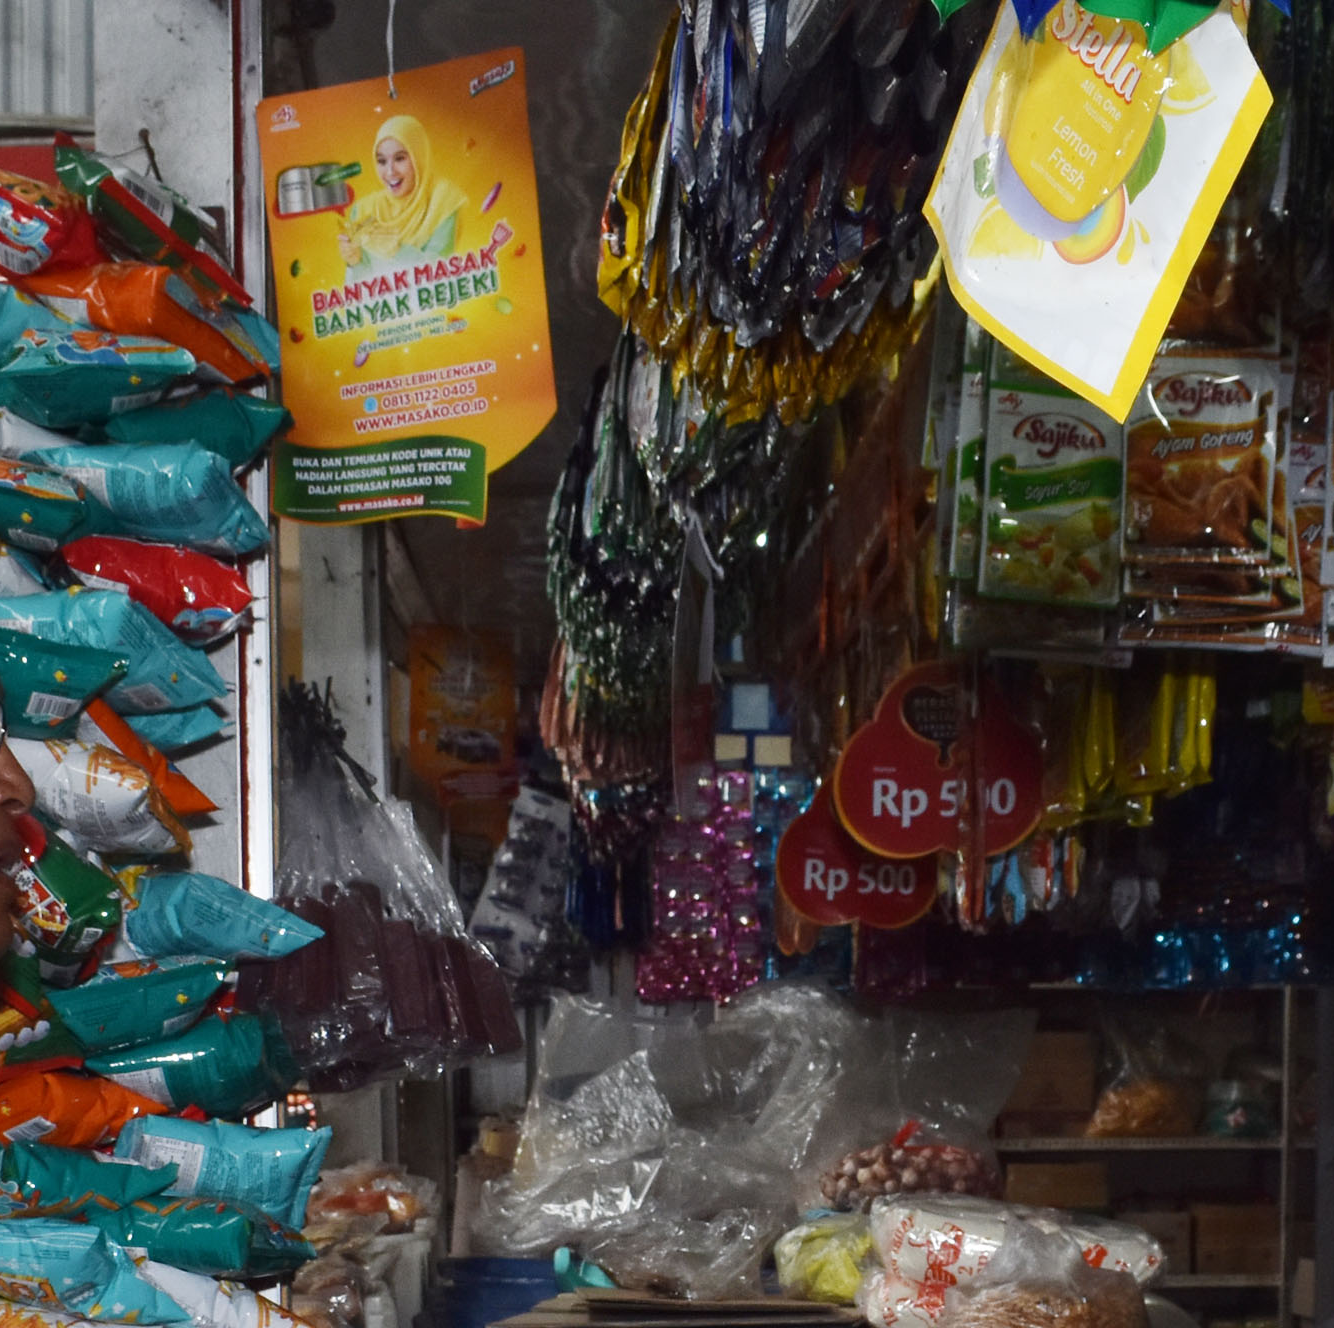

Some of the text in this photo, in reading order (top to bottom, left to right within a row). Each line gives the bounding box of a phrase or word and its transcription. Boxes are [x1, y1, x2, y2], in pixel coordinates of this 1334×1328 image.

[1052, 0, 1142, 105] Stella
[1080, 79, 1095, 98] All
[1102, 98, 1123, 121] One
[1052, 116, 1099, 166] Lemon
[1048, 147, 1087, 192] Fresh
[312, 247, 499, 313] BANYAK MASAK
[314, 269, 500, 338] BANYAK REJEKI
[341, 361, 497, 398] INFORMASI LEBIH LENGKAP:
[382, 382, 476, 410] 0813 1122 0405
[1165, 378, 1245, 417] Sajiku
[355, 398, 488, 432] WWW.MASAKO.CO.ID
[293, 447, 471, 468] BUKA DAN TEMUKAN KODE UNIK ATAU
[1024, 420, 1100, 459] Sajiku
[1150, 429, 1255, 459] Ayam Goreng
[308, 475, 453, 496] DALAM KEMASAN MASAKO 10G
[335, 467, 387, 481] LANGSUNG
[388, 464, 416, 476] YANG
[417, 461, 467, 472] TERCETAK
[339, 495, 424, 513] www.masako.co.id
[872, 777, 1017, 829] Rp 50
[803, 858, 916, 901] Rp 500
